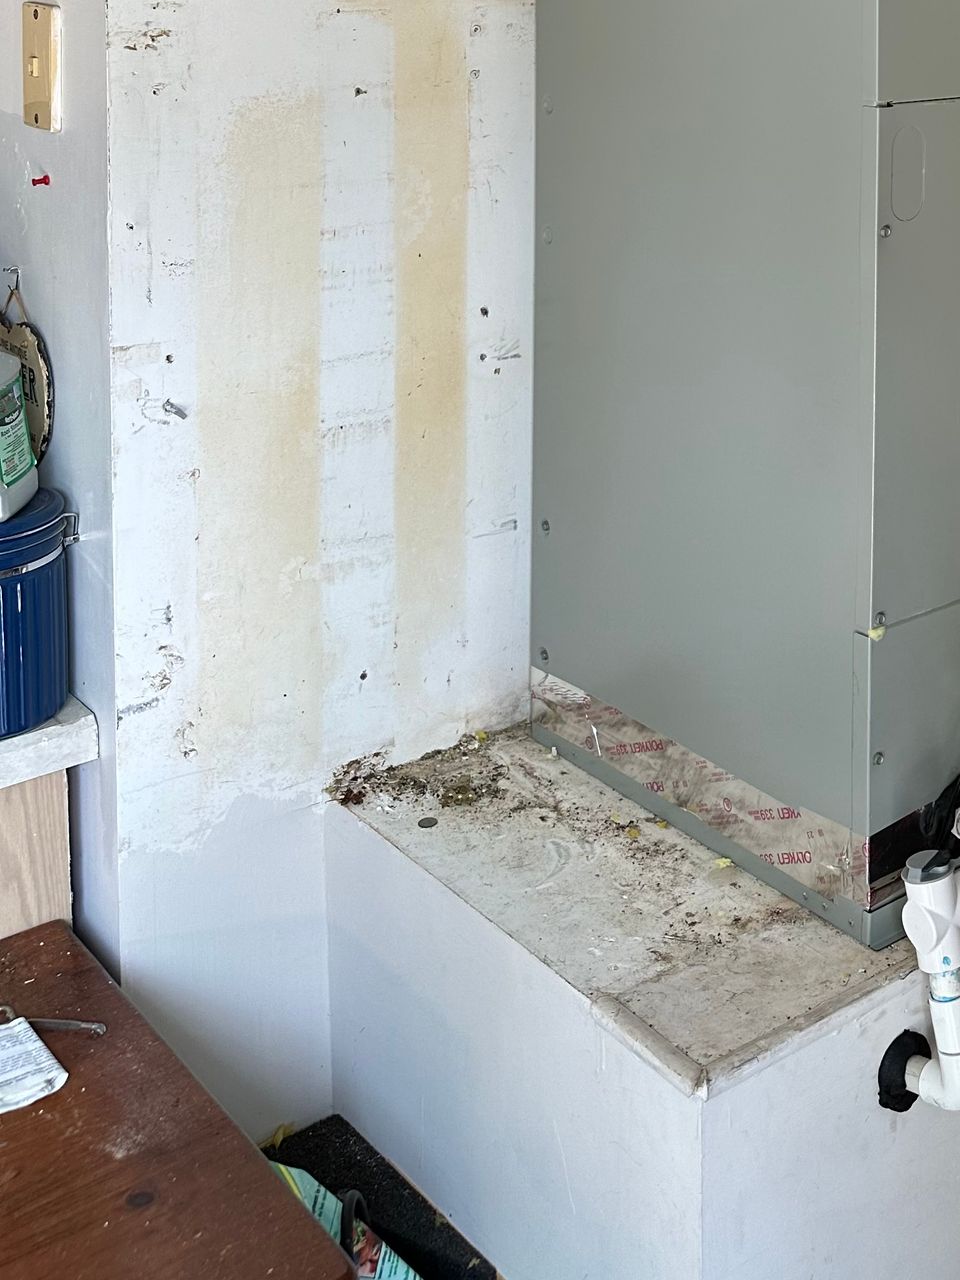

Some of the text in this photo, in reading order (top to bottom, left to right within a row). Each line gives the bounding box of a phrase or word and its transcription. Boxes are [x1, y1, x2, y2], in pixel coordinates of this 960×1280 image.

[616, 739, 664, 755] POLYKEN 339
[760, 809, 775, 821] 339
[776, 851, 812, 865] OLYKEN
